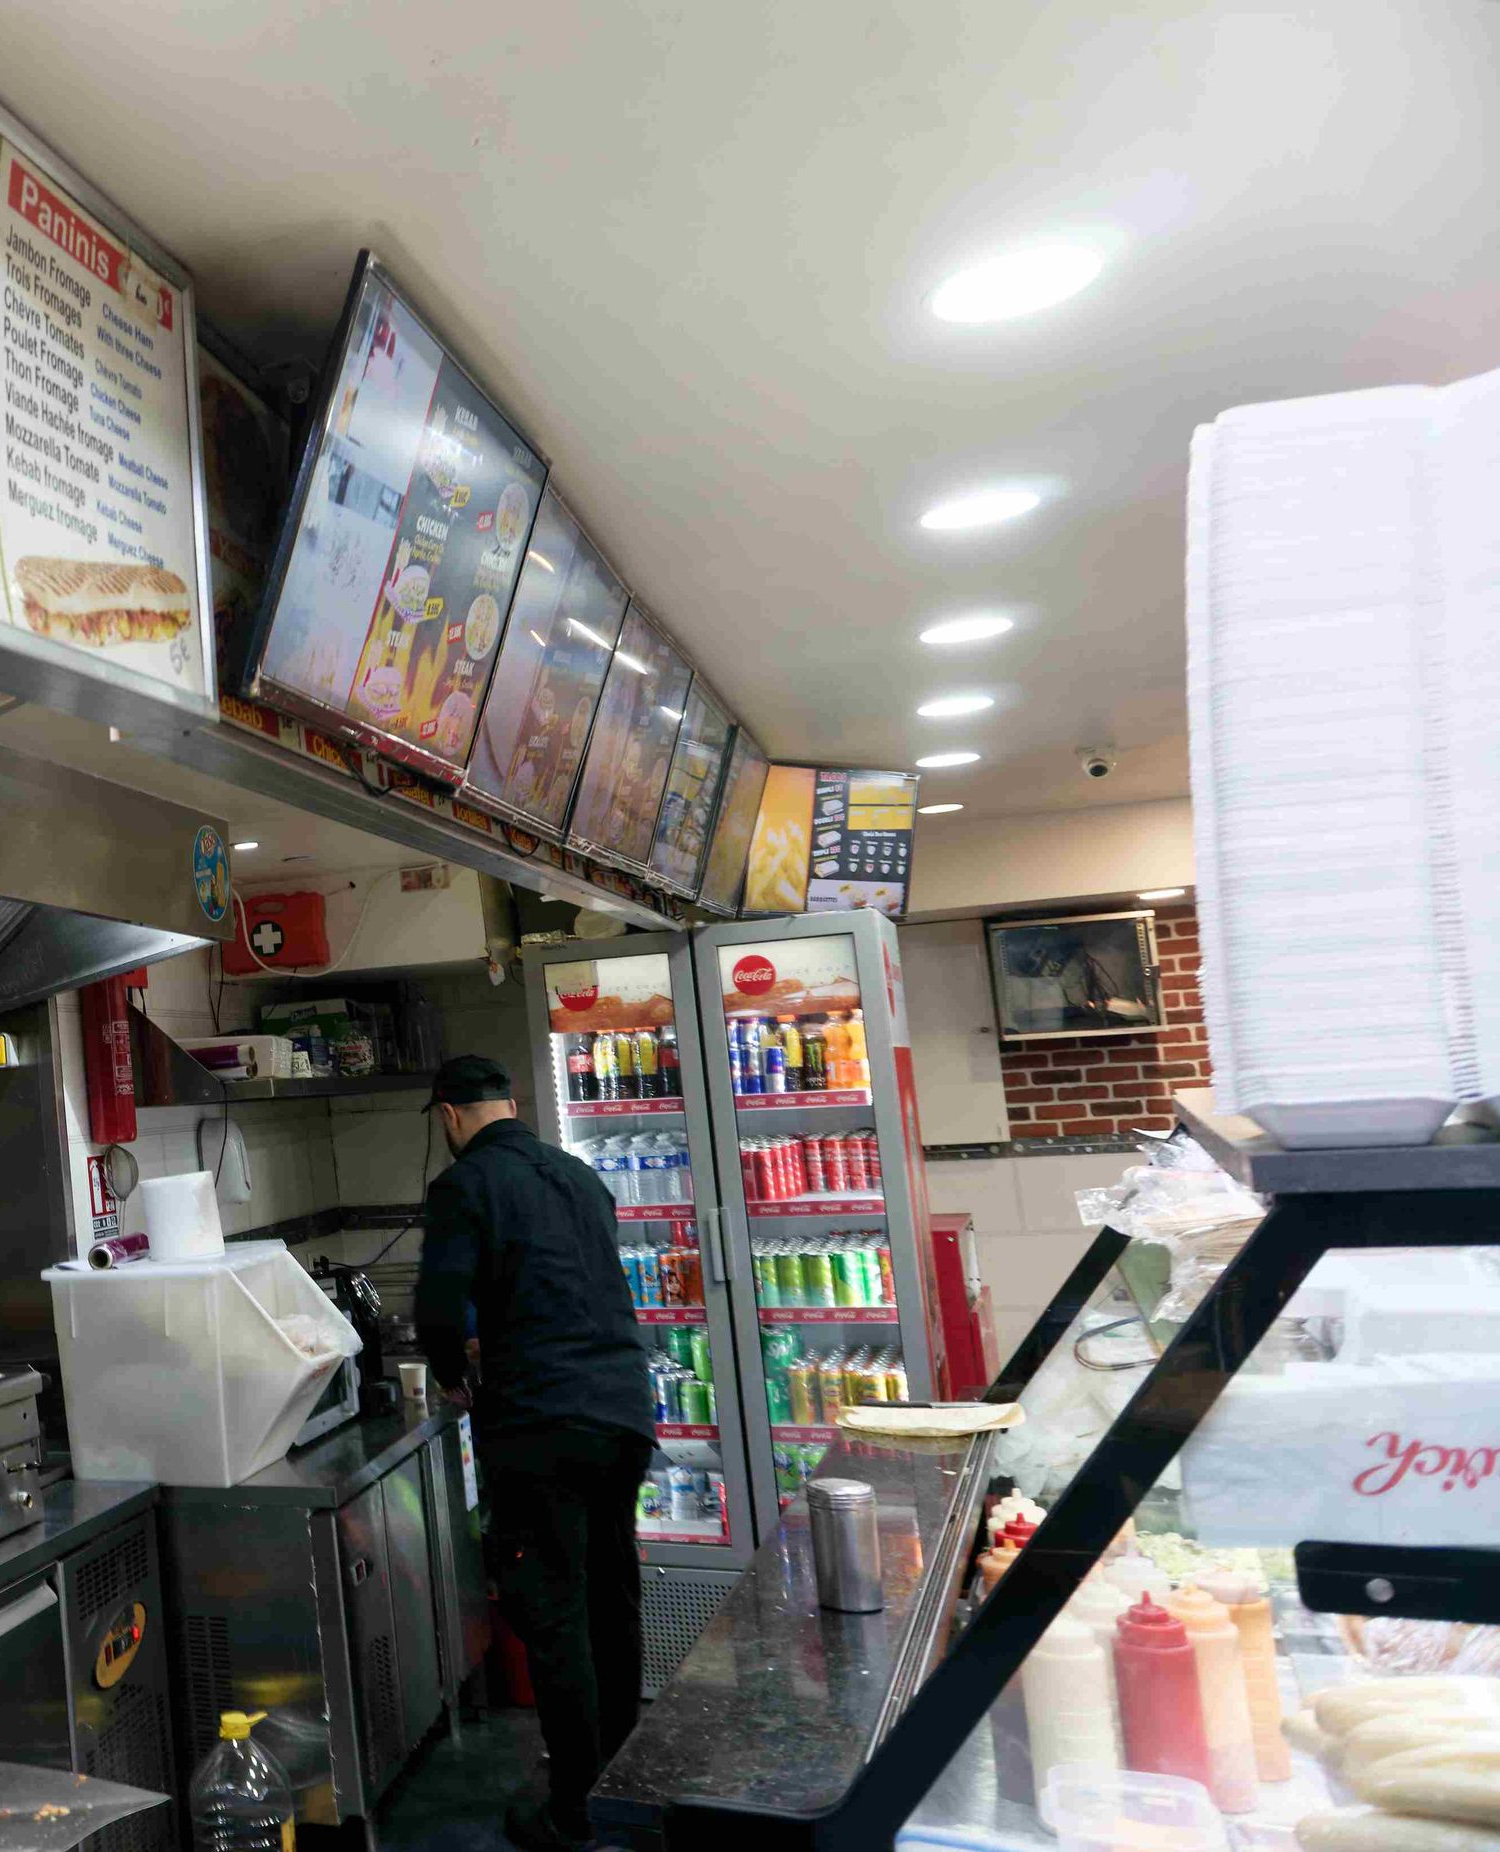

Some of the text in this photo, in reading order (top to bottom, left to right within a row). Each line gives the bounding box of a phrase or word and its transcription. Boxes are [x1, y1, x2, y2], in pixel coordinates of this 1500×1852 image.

[19, 171, 111, 283] Paninis
[5, 254, 82, 329] Trois Fromages
[6, 225, 91, 308] Jambon Fromage
[3, 317, 84, 389] Poulet Fromage
[43, 314, 85, 360] Tomates
[4, 346, 79, 414] Thon Fromage
[5, 378, 39, 419] Viande
[5, 412, 100, 484] Mozzarella Tomate
[6, 445, 86, 508] Kebab fromage
[8, 478, 54, 522] Merguez
[56, 502, 98, 545] fromage
[416, 514, 450, 541] CHICKEN
[453, 658, 476, 677] STEAK
[220, 695, 264, 730] ebab
[734, 967, 773, 983] Coca-Cola
